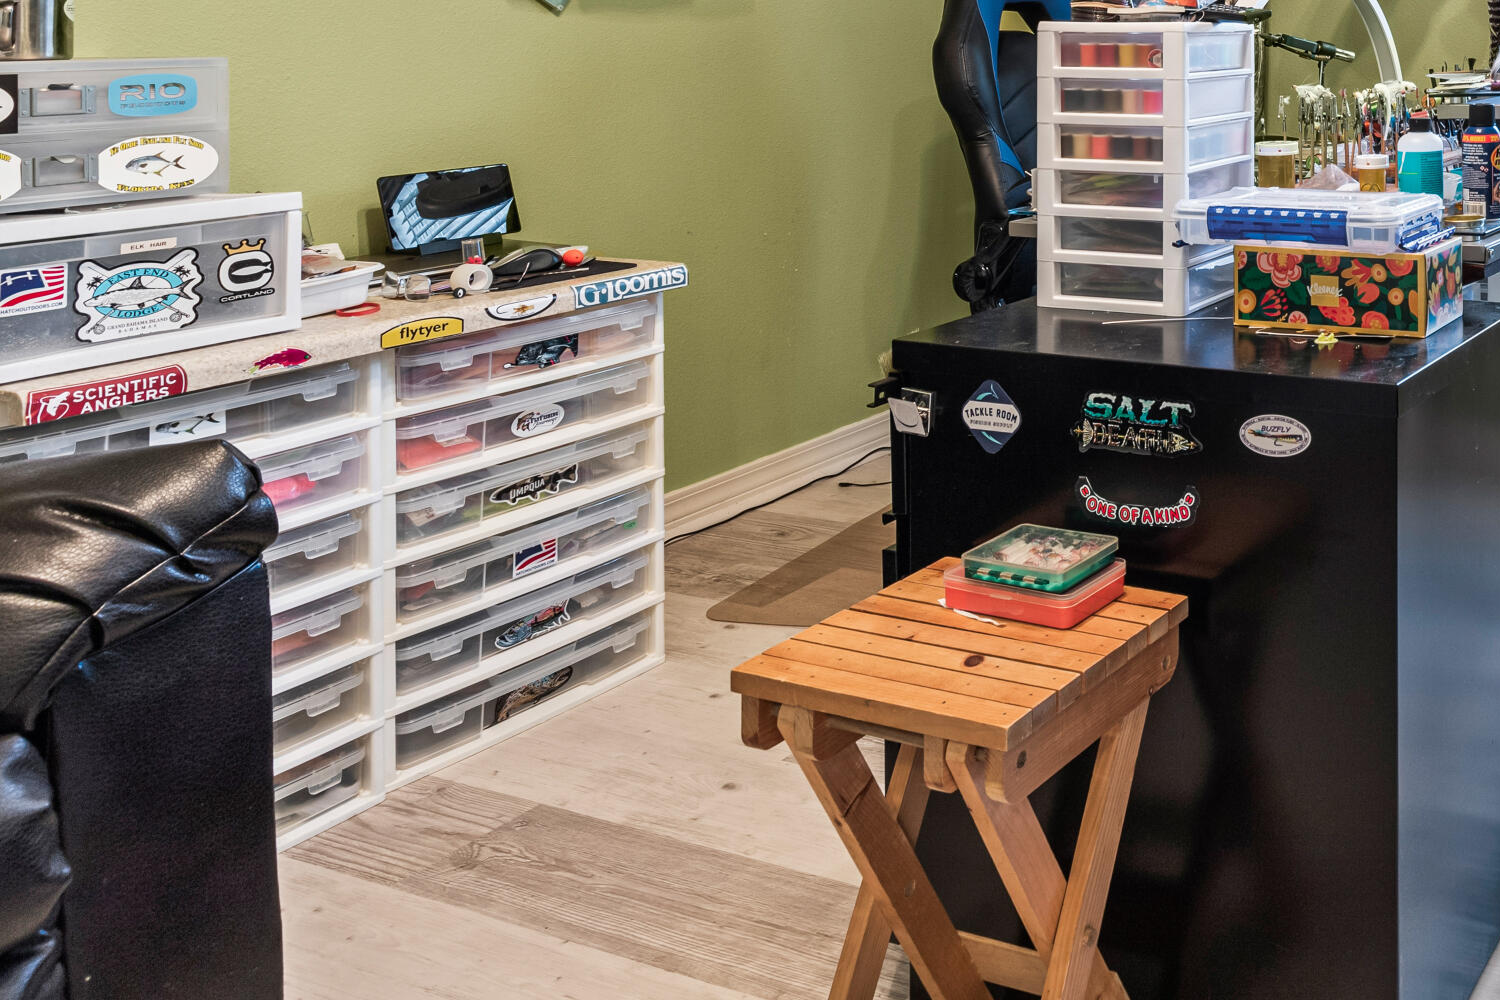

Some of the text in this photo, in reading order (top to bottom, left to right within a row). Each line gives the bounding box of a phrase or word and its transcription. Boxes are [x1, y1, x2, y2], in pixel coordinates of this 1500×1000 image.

[120, 82, 185, 101] RIO
[117, 184, 164, 192] FLORIDA
[108, 268, 170, 285] EAST END
[221, 288, 274, 303] CORTLAND
[1307, 283, 1342, 297] Kleenex
[116, 306, 160, 318] LODGE
[399, 320, 448, 341] flytyer
[72, 373, 177, 402] SCIENTIFIC
[80, 387, 170, 414] ANGLERS
[1084, 392, 1192, 426] SALT
[965, 408, 1017, 423] TACKLE ROOM
[1261, 425, 1291, 433] BUZFLY
[510, 478, 545, 500] UMPQUA
[1119, 506, 1140, 522] OF
[1141, 508, 1153, 524] A
